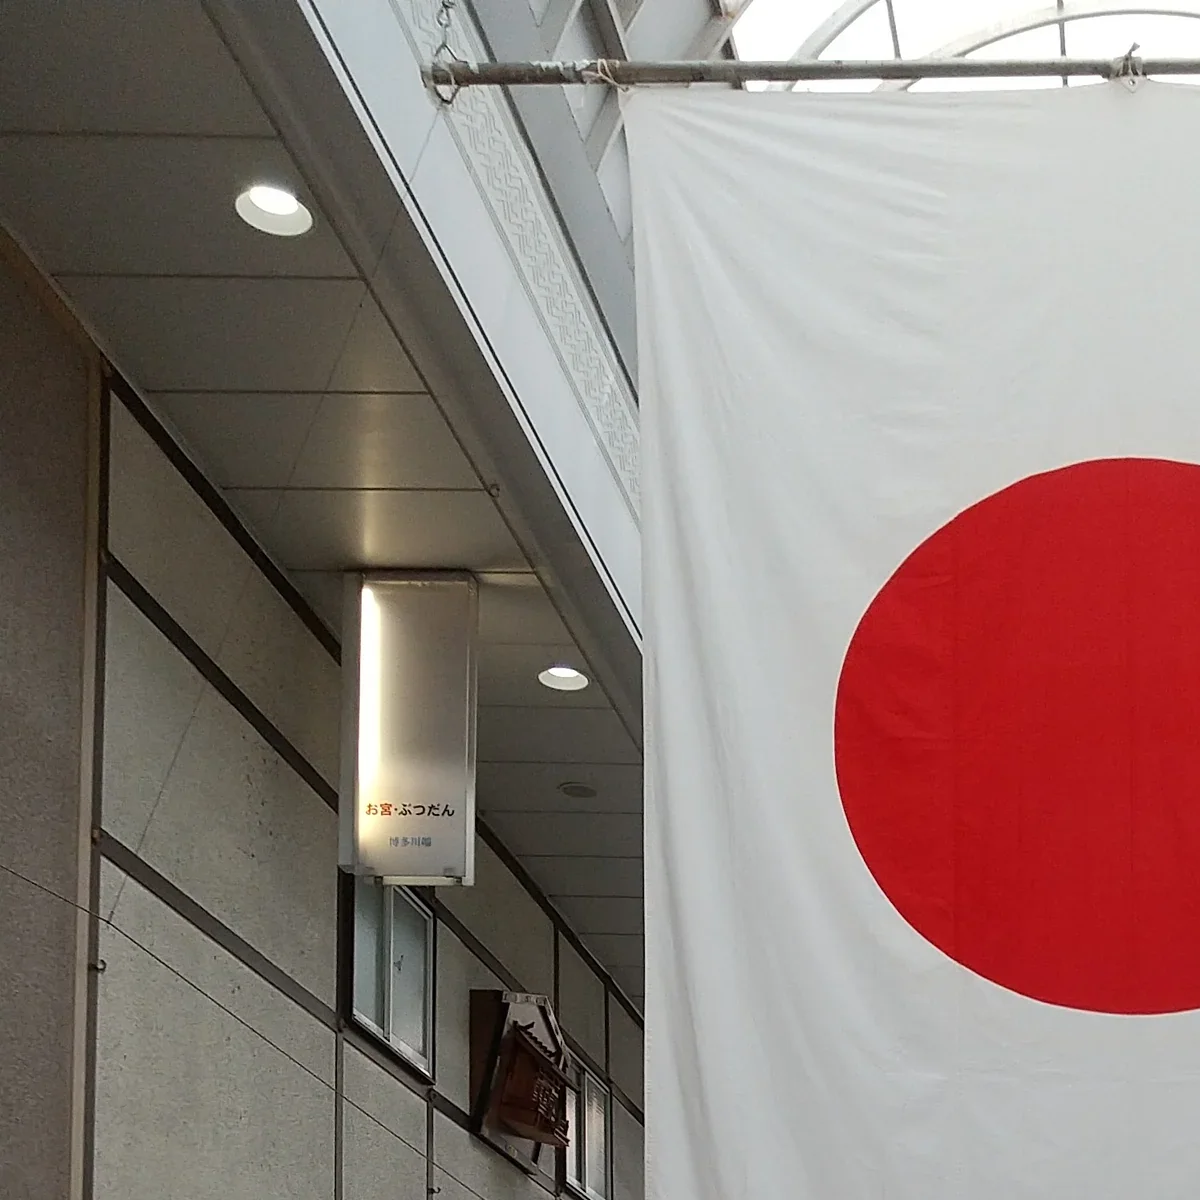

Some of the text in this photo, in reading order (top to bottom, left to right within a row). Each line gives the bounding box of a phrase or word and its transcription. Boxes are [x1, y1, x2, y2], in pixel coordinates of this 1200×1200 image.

[365, 803, 455, 818] お宮・ぶつだん
